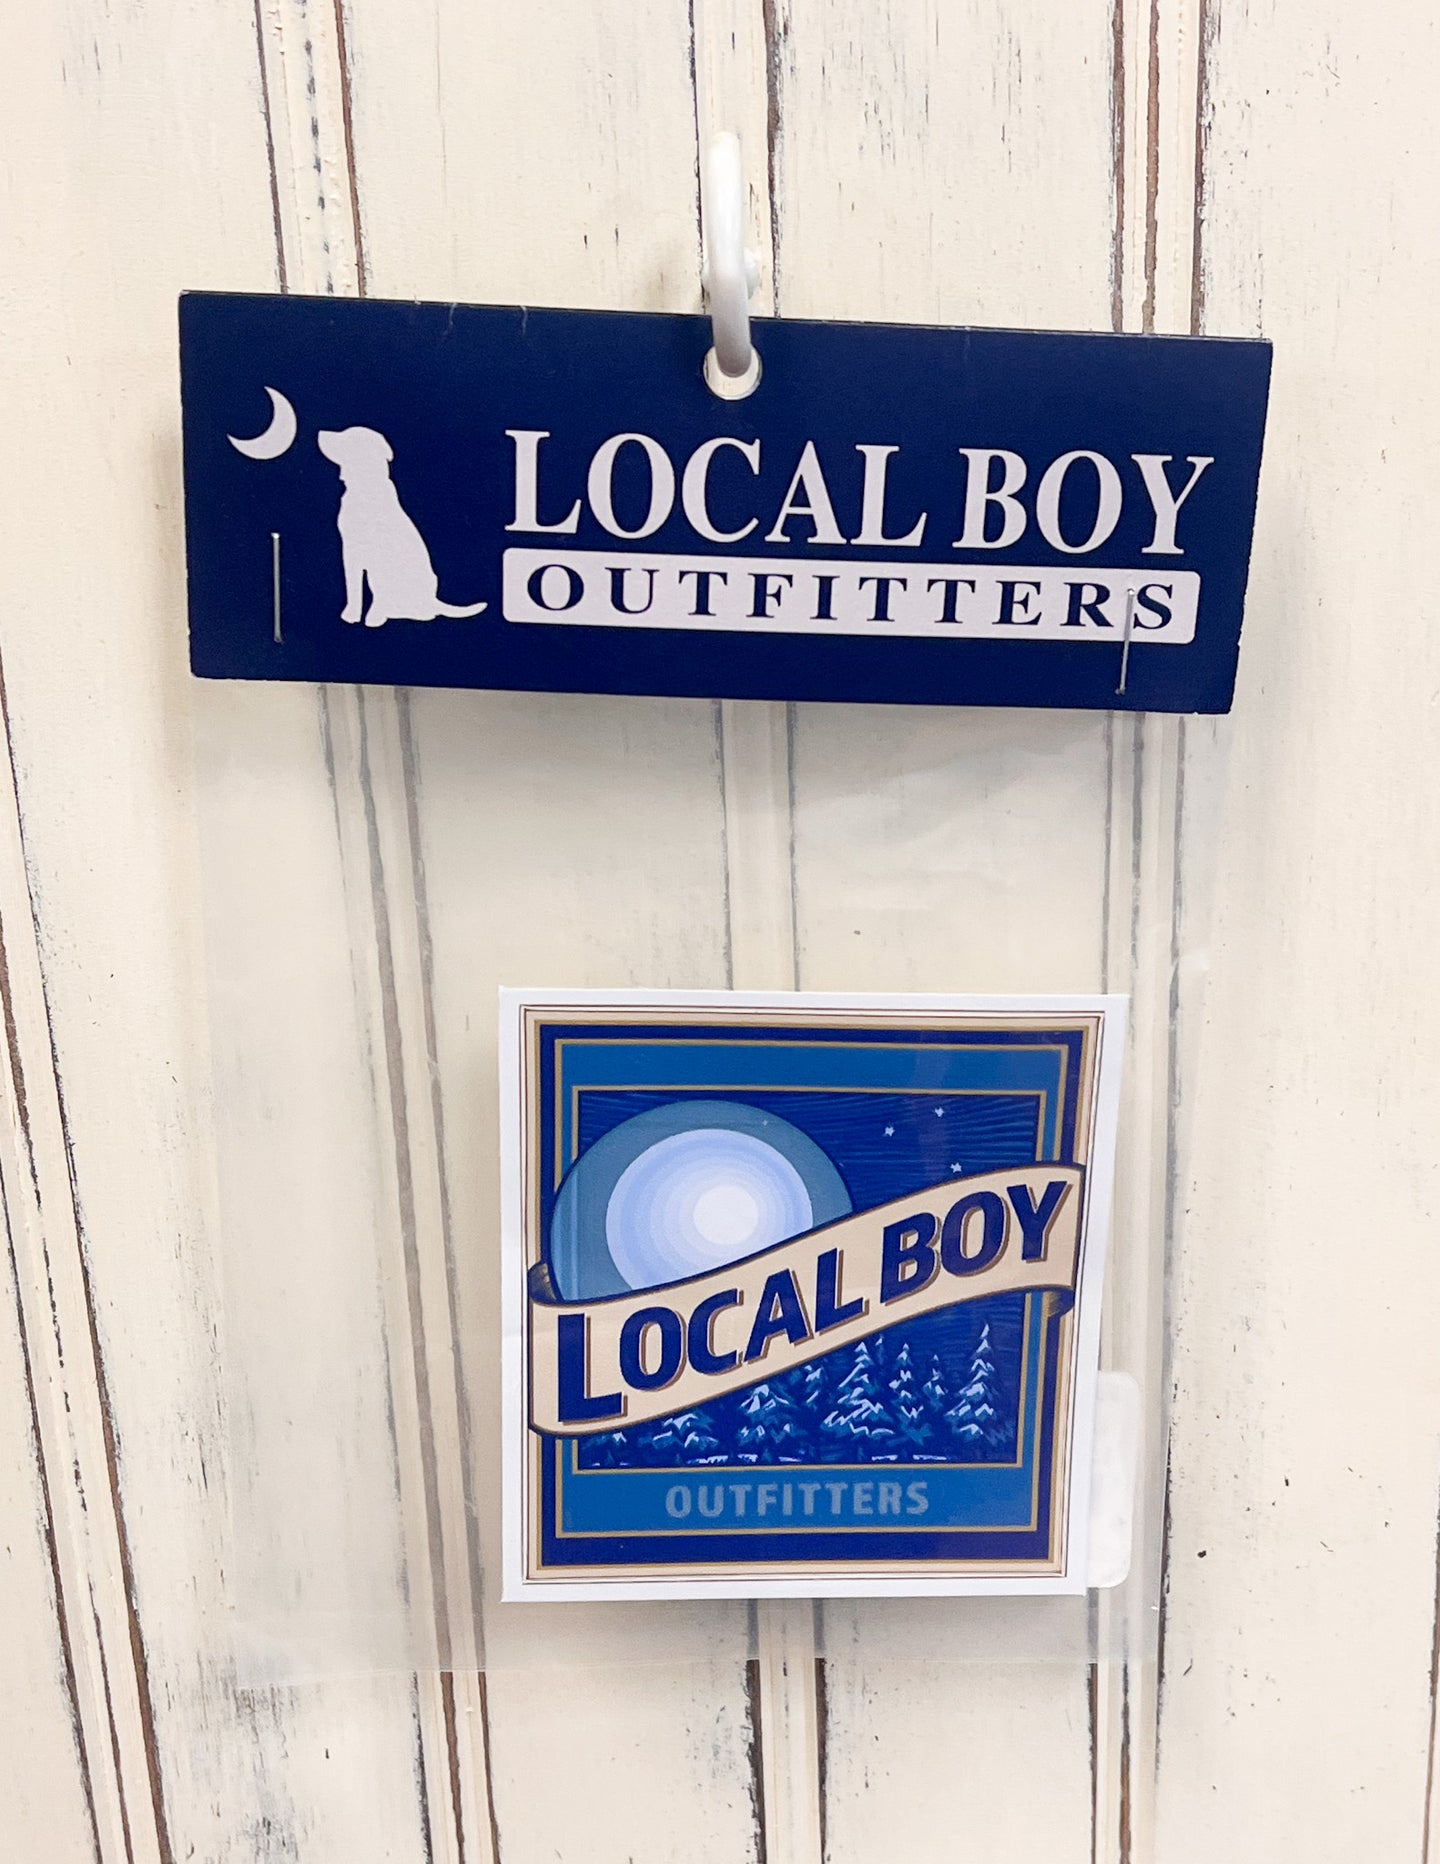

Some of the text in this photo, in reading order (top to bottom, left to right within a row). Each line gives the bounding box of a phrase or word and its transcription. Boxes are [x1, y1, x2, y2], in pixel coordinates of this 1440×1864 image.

[504, 428, 1214, 557] LOCAL BOY
[524, 562, 1175, 632] OUTFITTERS
[556, 1179, 1074, 1426] LOCAL BOY
[665, 1480, 930, 1520] OUTFITTERS
